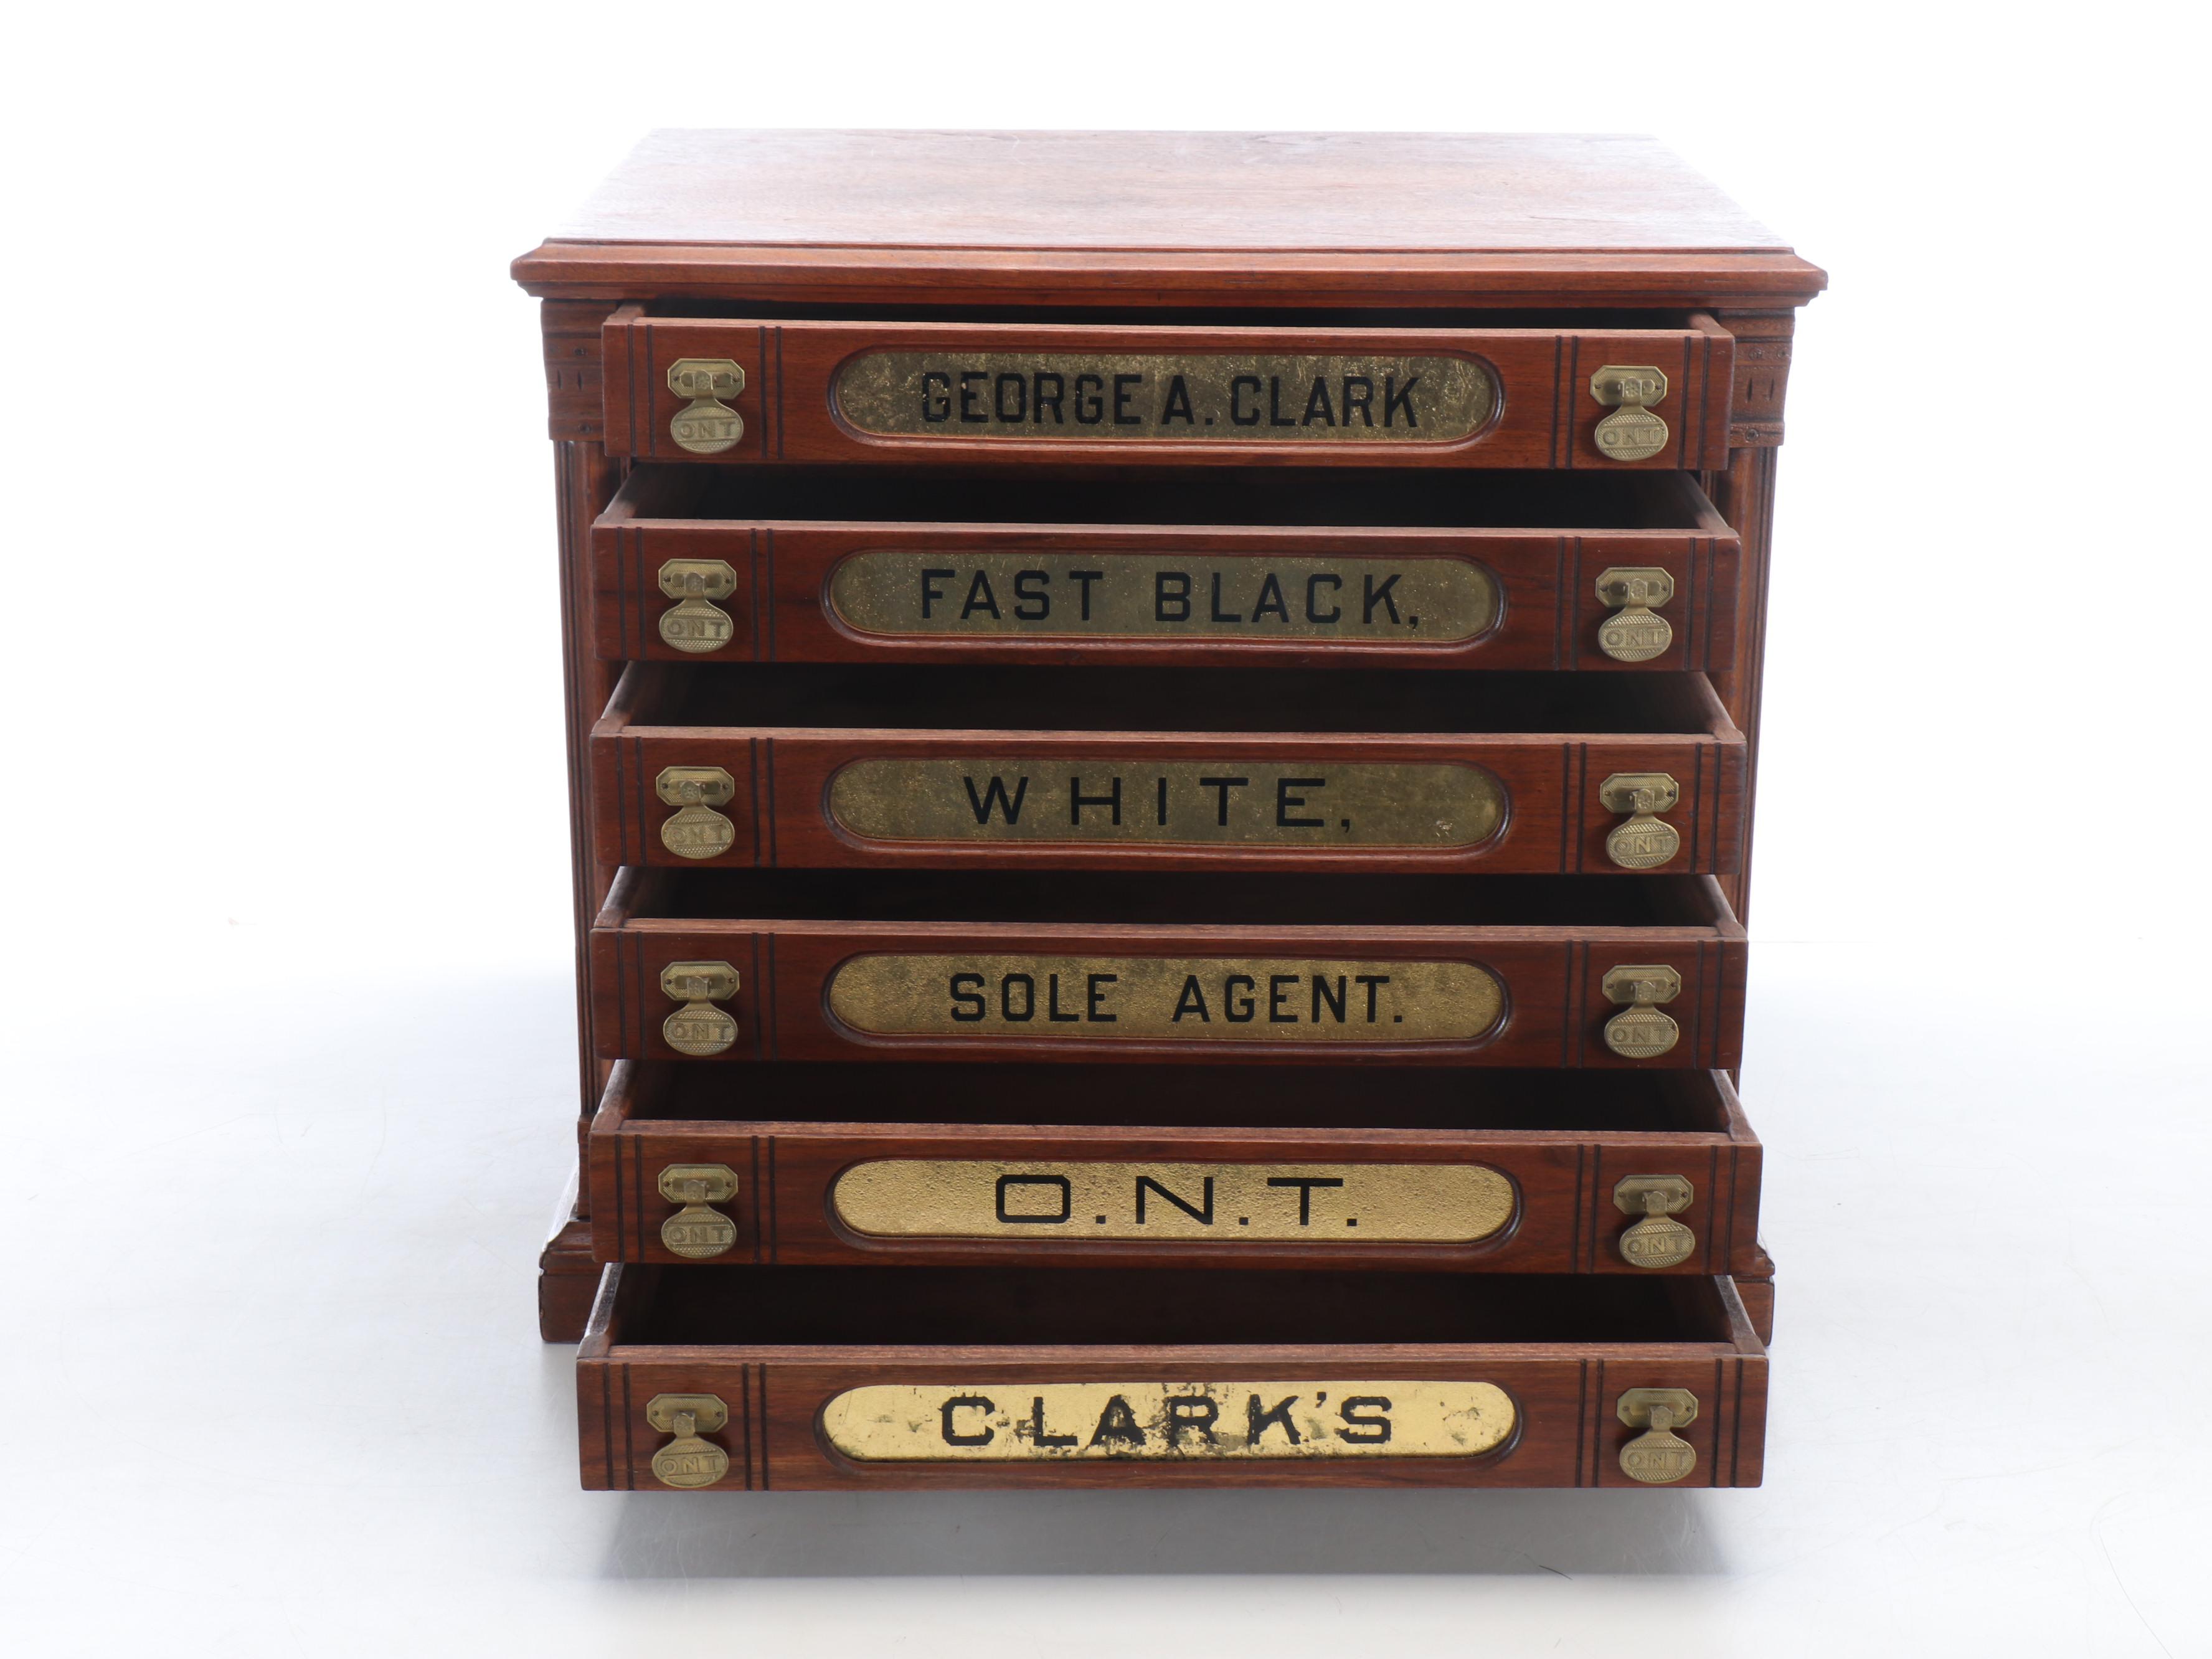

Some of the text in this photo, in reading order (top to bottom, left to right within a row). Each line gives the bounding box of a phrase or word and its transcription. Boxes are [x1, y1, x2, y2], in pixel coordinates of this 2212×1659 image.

[922, 372, 1420, 427] GEORGE A. CLARK
[680, 421, 735, 439] ONT
[1604, 428, 1660, 445] ONT
[920, 569, 1419, 629] FAST BLACK,
[667, 619, 727, 637] ONT
[1607, 628, 1665, 646] ONT
[963, 776, 1351, 833] WHITE,
[670, 825, 725, 843] ONT
[1615, 836, 1671, 854] ONT
[950, 973, 1403, 1023] SOLE AGENT.
[673, 1023, 730, 1041] ONT
[1613, 1028, 1671, 1042] ONT
[996, 1174, 1358, 1226] O.N.T.
[669, 1226, 729, 1244] ONT
[1629, 1236, 1688, 1254] ONT
[940, 1391, 1392, 1447] CLARK'S
[660, 1456, 721, 1473] ONT
[1628, 1452, 1687, 1469] ONT
